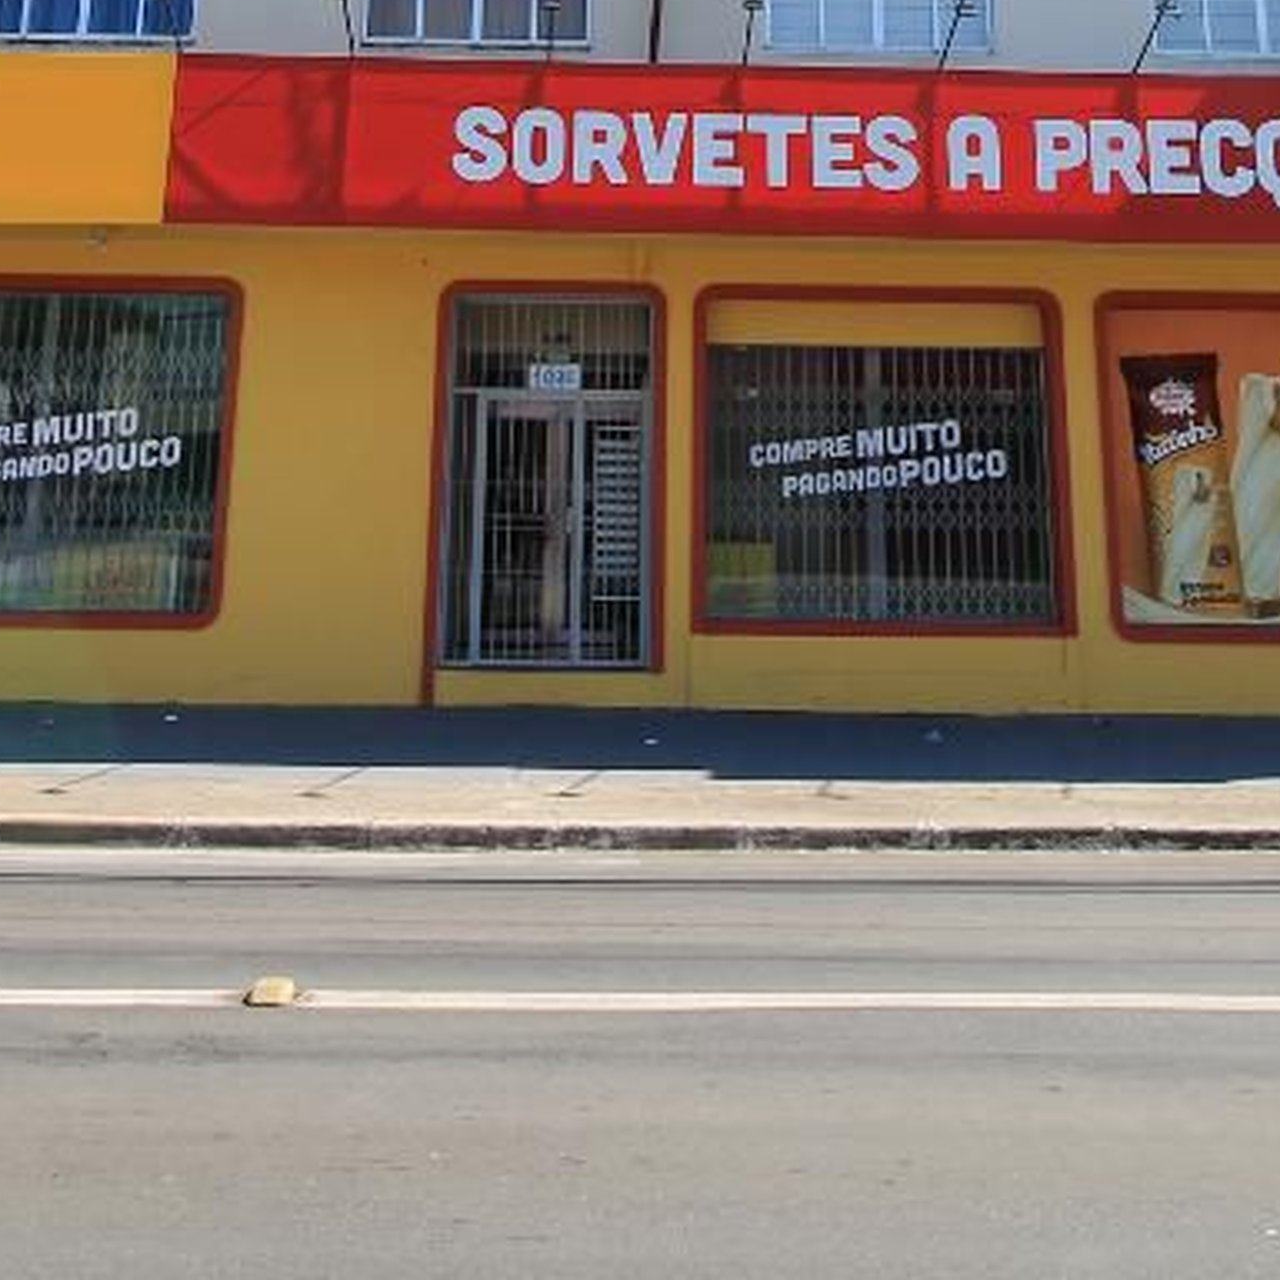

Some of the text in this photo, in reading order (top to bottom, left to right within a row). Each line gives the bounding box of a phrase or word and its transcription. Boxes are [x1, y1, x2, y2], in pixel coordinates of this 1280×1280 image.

[452, 106, 920, 191] SORVETES
[946, 114, 1002, 190] A
[32, 406, 139, 447] MUITO
[749, 419, 962, 468] COMPRE MUITO
[71, 435, 182, 476] POUCO
[782, 448, 1009, 498] PAGANDO POUCO
